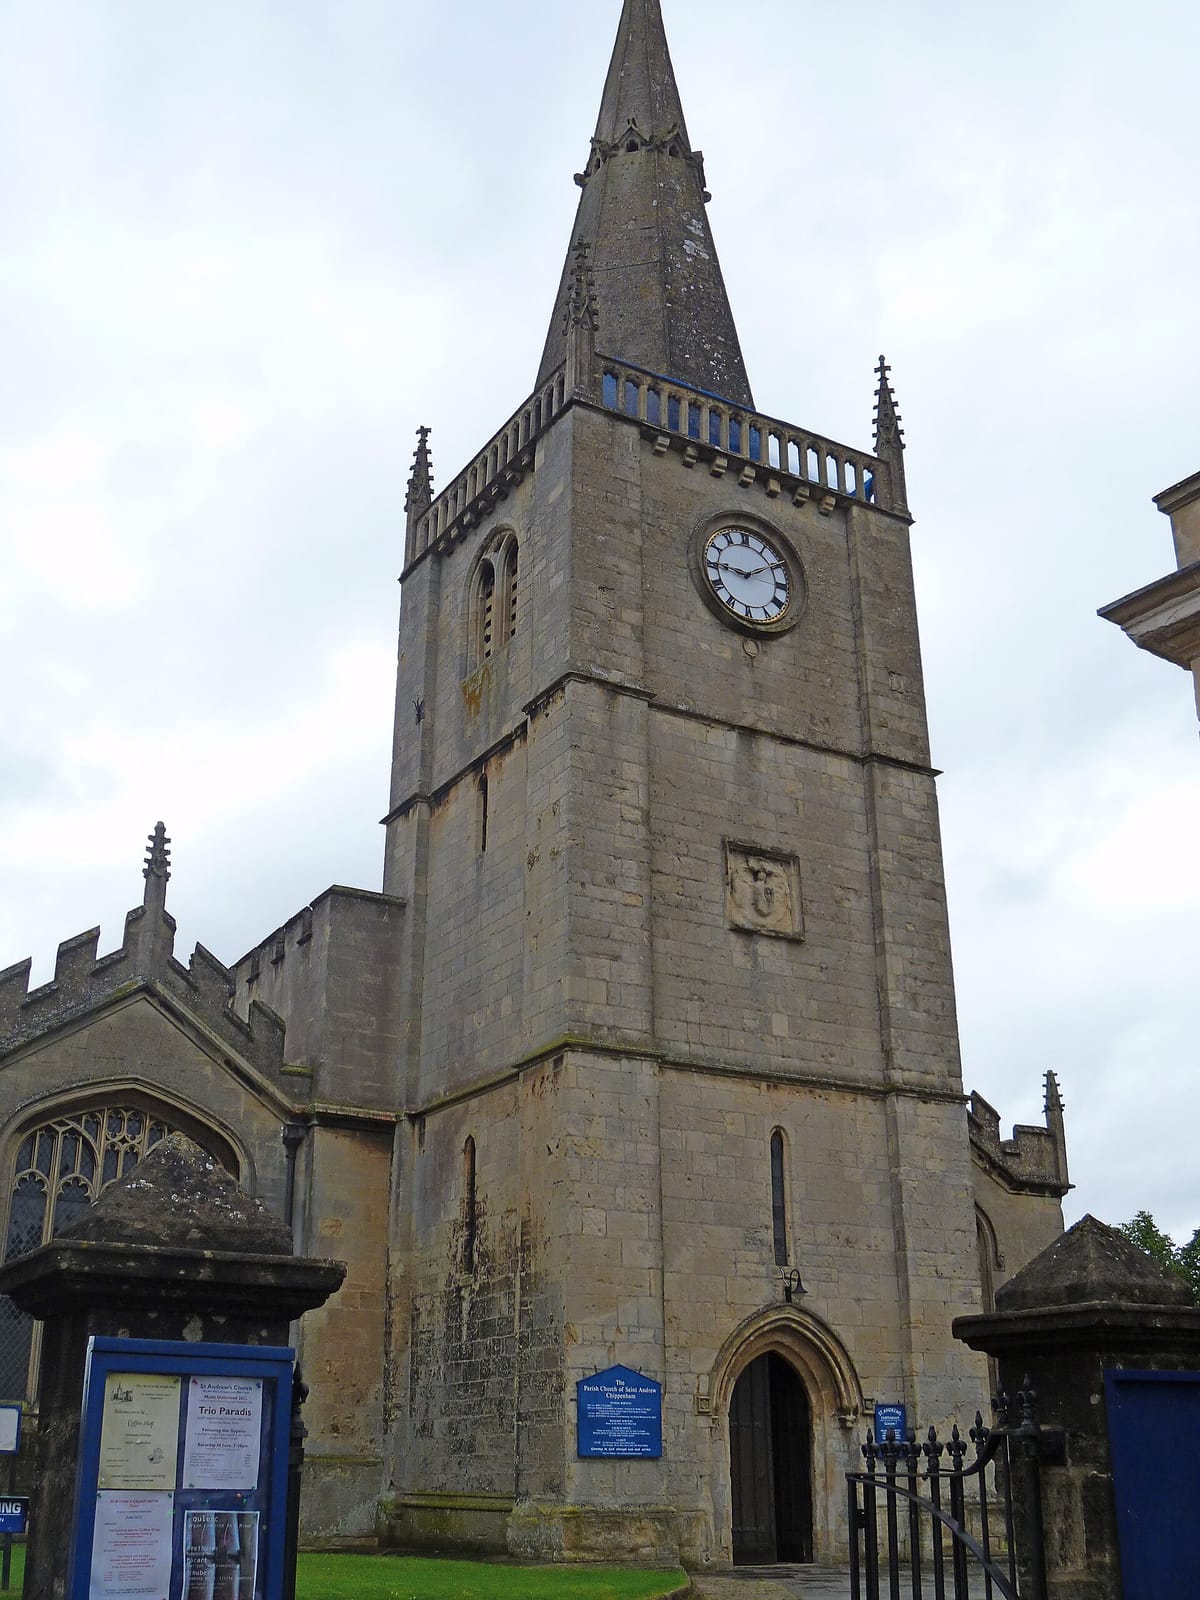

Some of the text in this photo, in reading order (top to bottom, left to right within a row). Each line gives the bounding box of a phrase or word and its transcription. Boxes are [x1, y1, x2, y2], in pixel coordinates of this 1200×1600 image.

[605, 1392, 636, 1400] Chippenham
[198, 1406, 252, 1416] Trio Paradis
